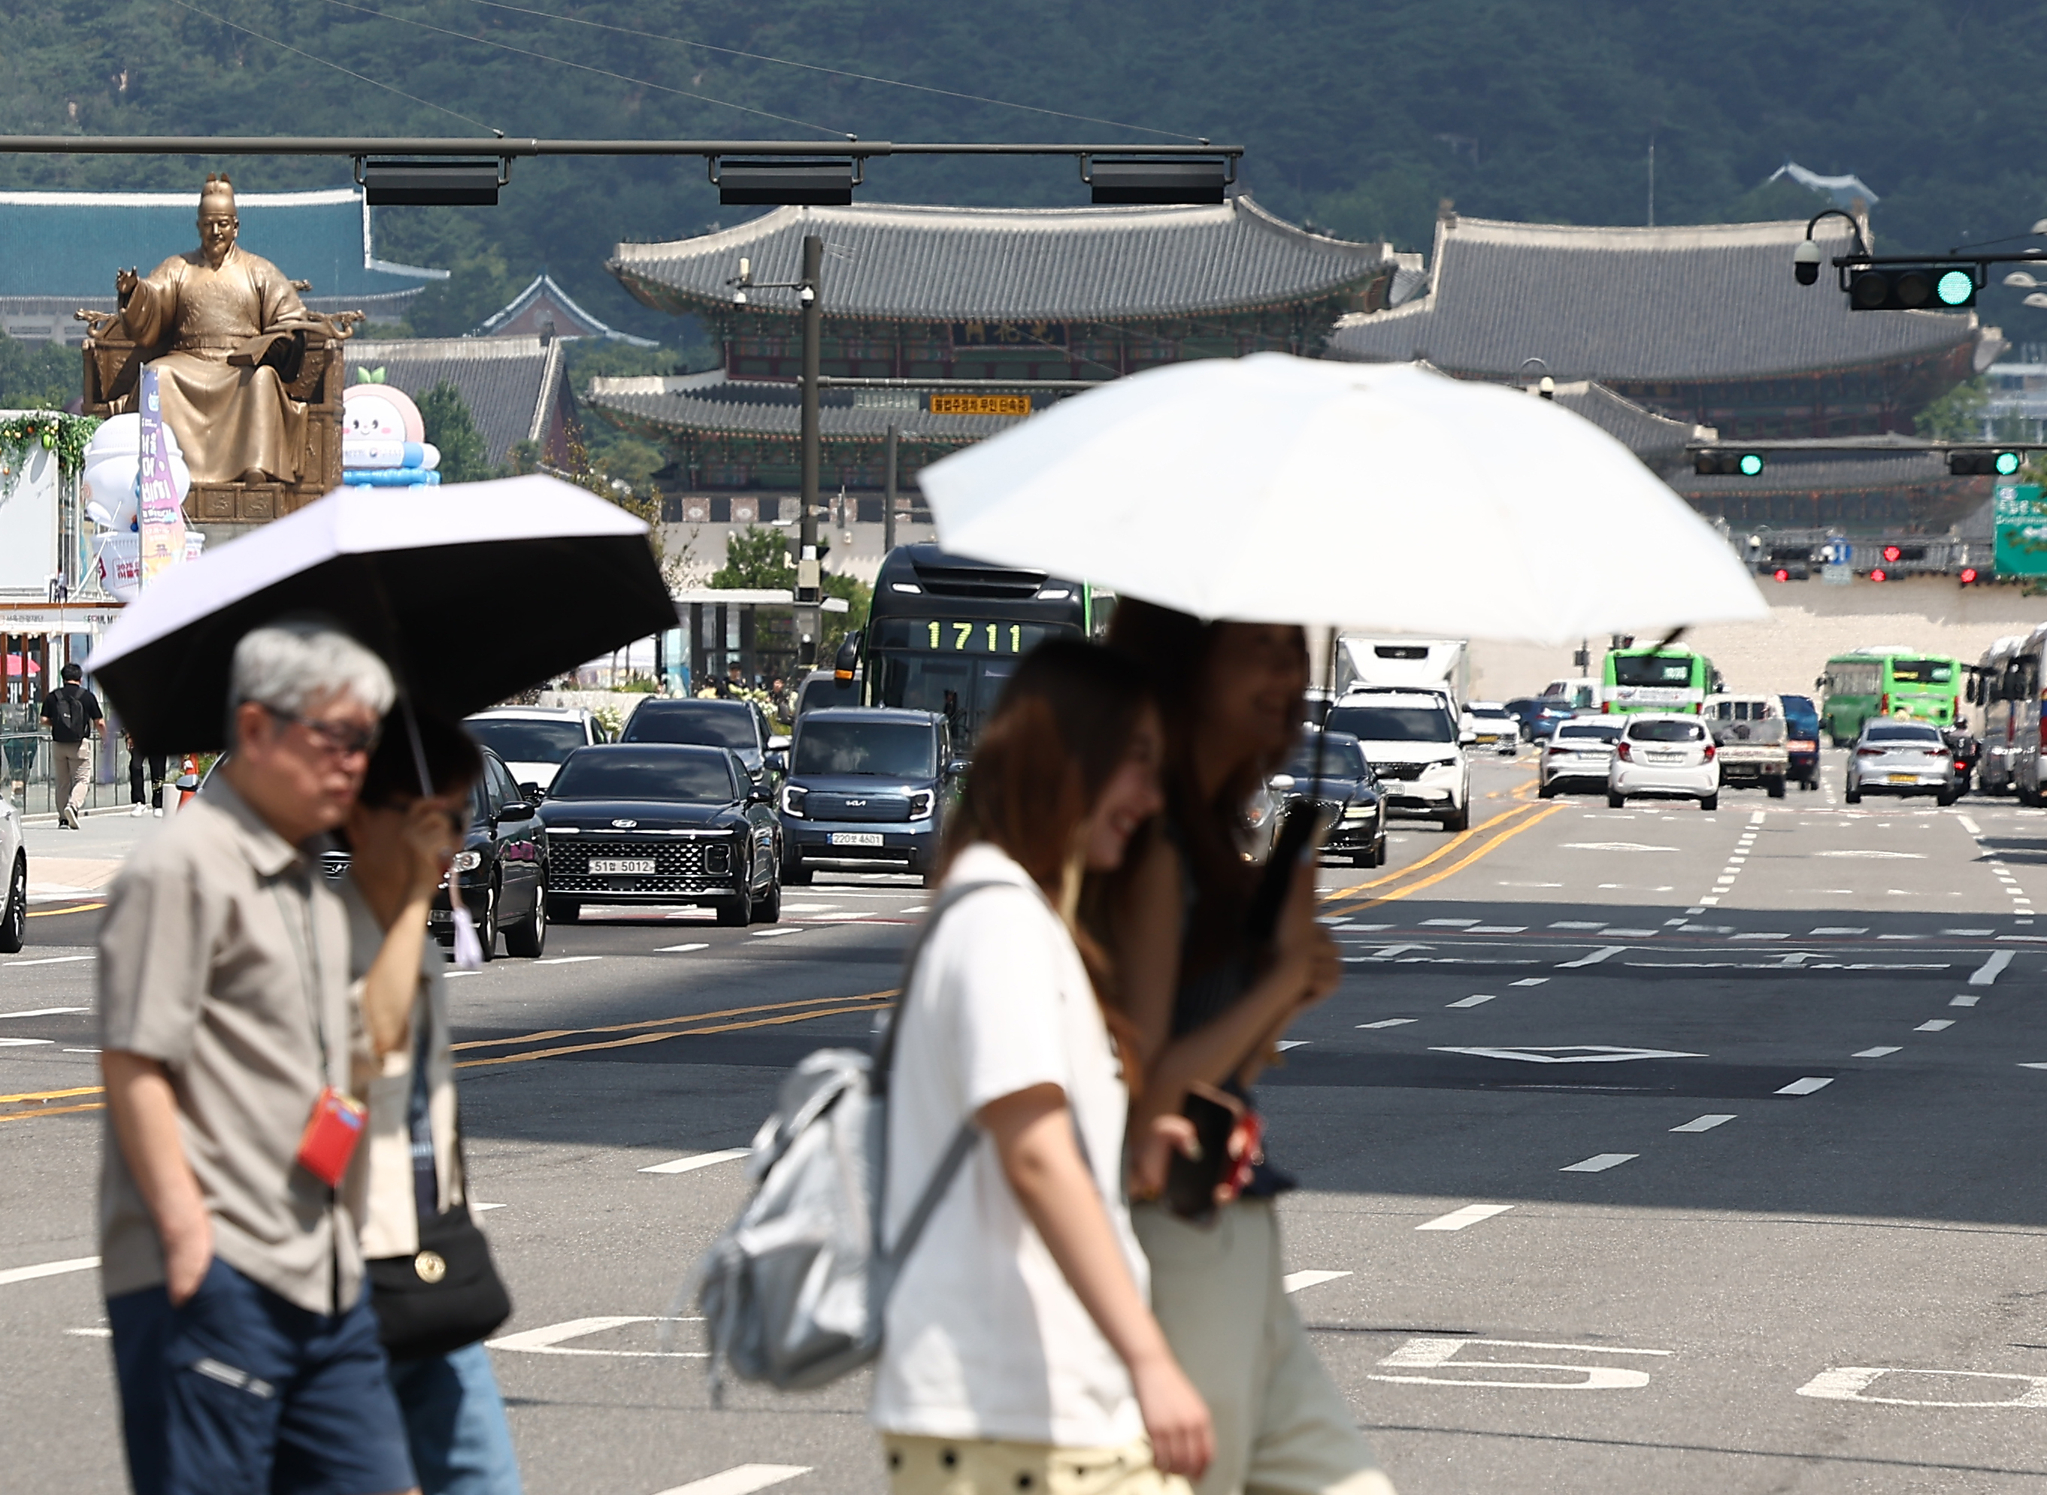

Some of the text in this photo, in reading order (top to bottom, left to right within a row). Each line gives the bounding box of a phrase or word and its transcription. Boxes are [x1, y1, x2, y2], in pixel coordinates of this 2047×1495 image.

[936, 399, 1026, 412] 불법주정차 무인 단속중
[928, 621, 1020, 653] 1711
[621, 861, 649, 872] 5012
